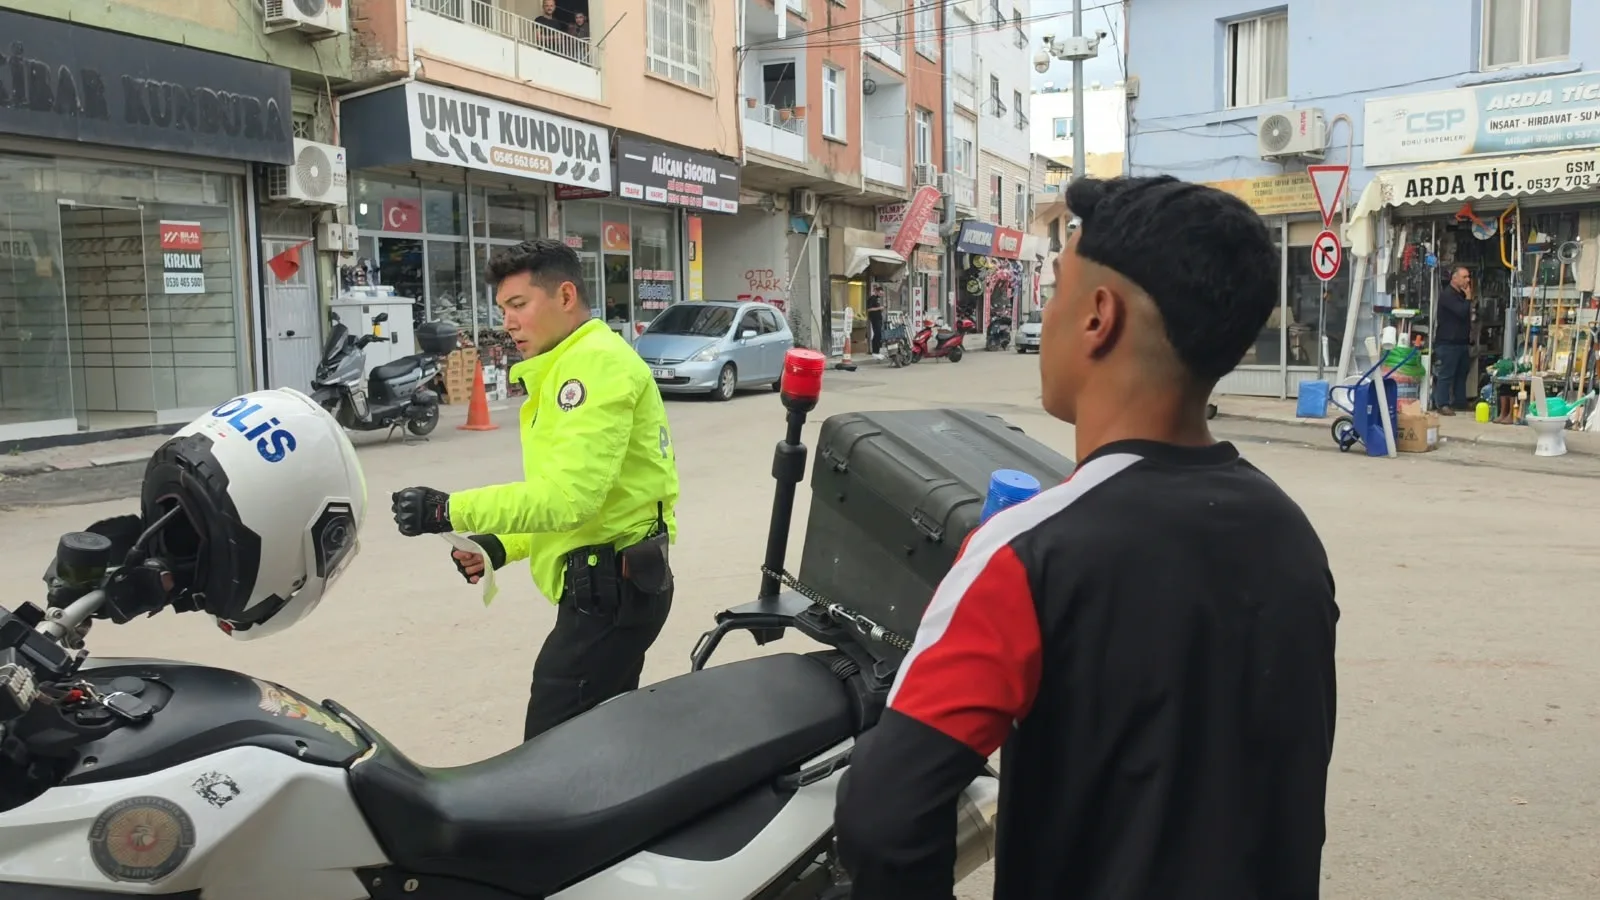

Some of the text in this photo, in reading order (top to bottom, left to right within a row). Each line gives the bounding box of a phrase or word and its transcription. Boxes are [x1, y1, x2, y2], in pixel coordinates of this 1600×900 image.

[122, 74, 286, 142] KUNDURA
[1486, 89, 1553, 111] ARDA
[418, 93, 601, 163] UMUT KUNDURA
[1406, 108, 1465, 133] CSP
[1528, 113, 1572, 127] HIRDAVAT
[1580, 111, 1592, 122] SU
[494, 150, 513, 165] 0545
[651, 152, 717, 185] ALİCAN SİGORTA
[1566, 161, 1595, 173] GSM
[1405, 174, 1465, 198] ARDA
[1475, 168, 1522, 192] TİC.
[1527, 177, 1560, 190] 0537
[1565, 174, 1590, 187] 703
[745, 269, 773, 280] OTO
[749, 279, 783, 291] PARK
